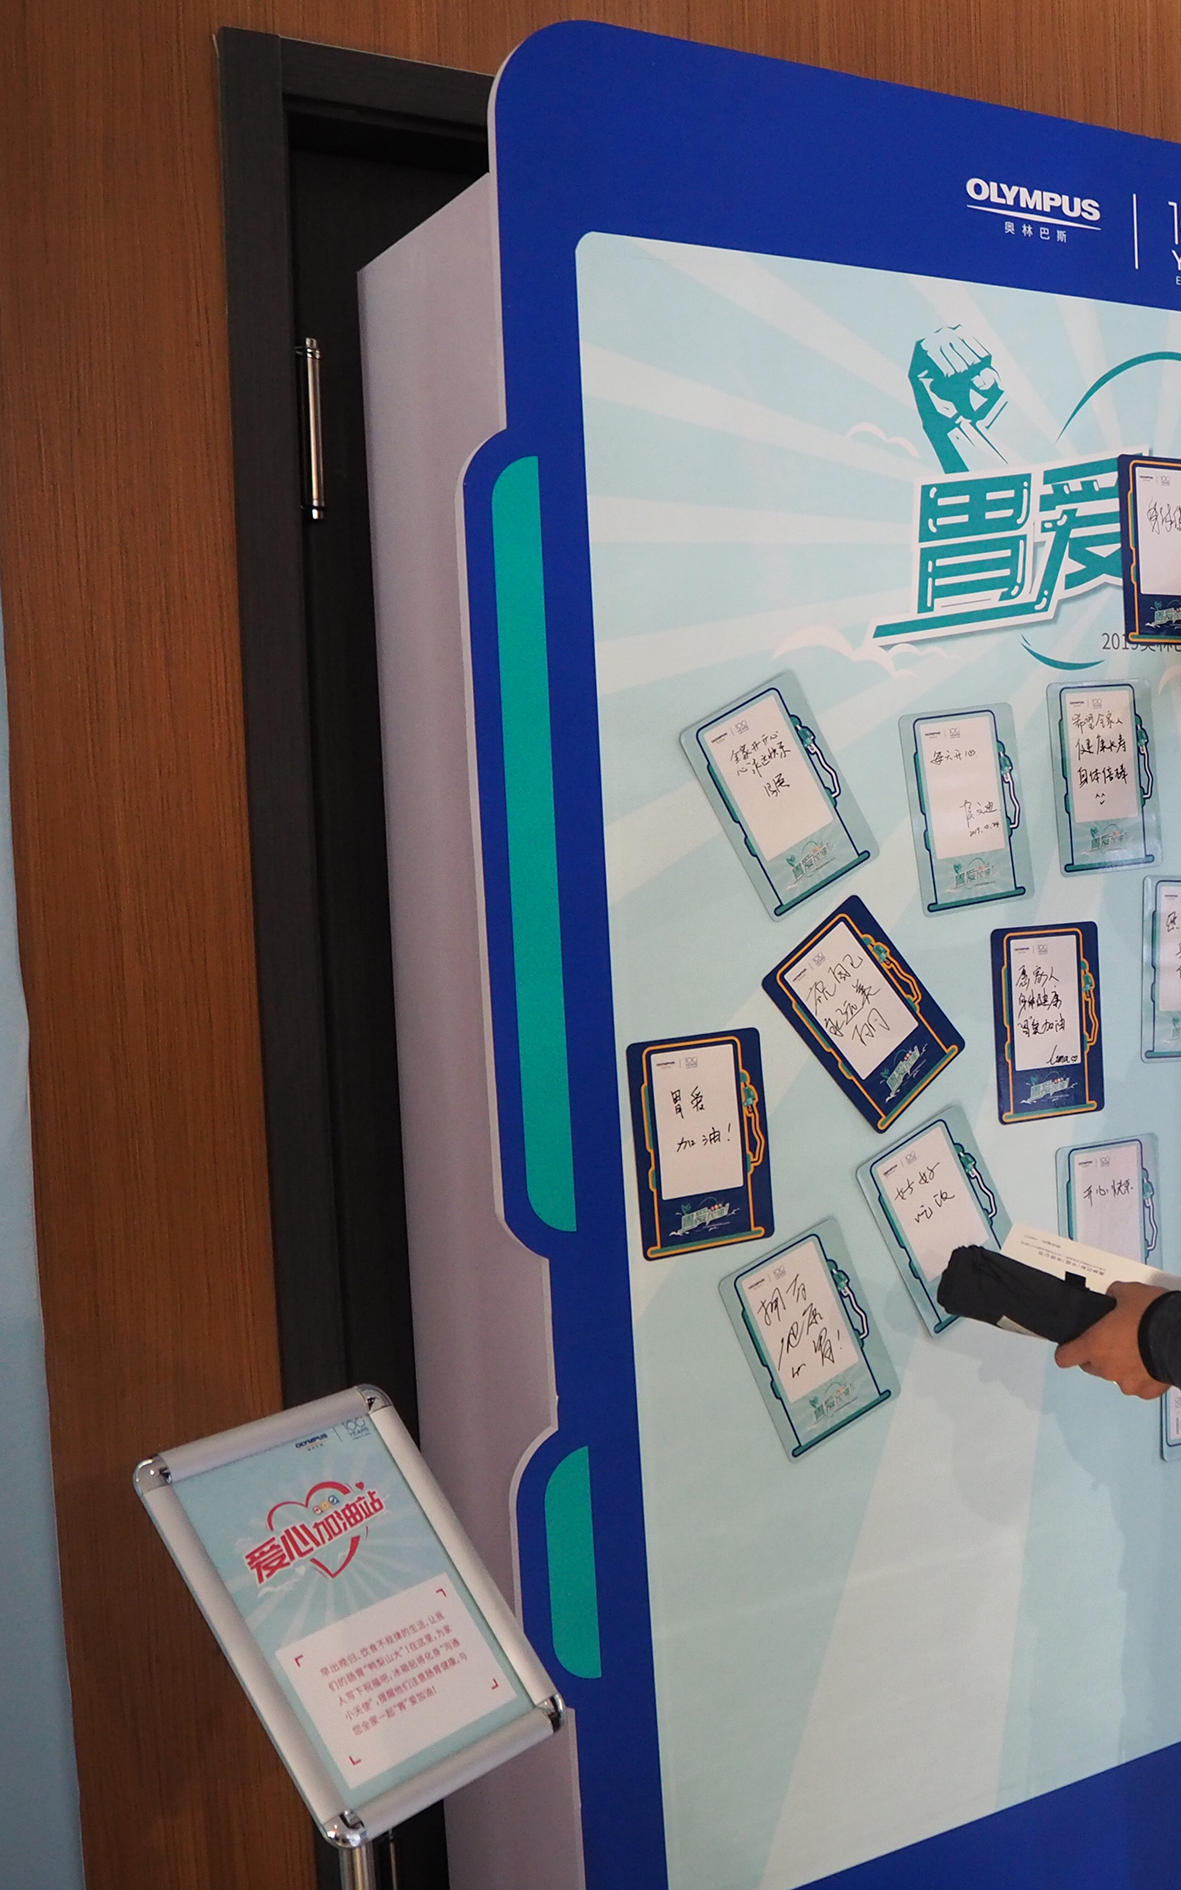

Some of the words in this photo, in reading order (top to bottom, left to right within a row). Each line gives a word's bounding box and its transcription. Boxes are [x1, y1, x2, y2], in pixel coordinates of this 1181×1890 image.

[966, 178, 1101, 221] OLYMPUS
[1004, 221, 1067, 243] 奥林巴斯
[676, 1122, 733, 1153] 加油!
[245, 1490, 385, 1585] 爱心加油站
